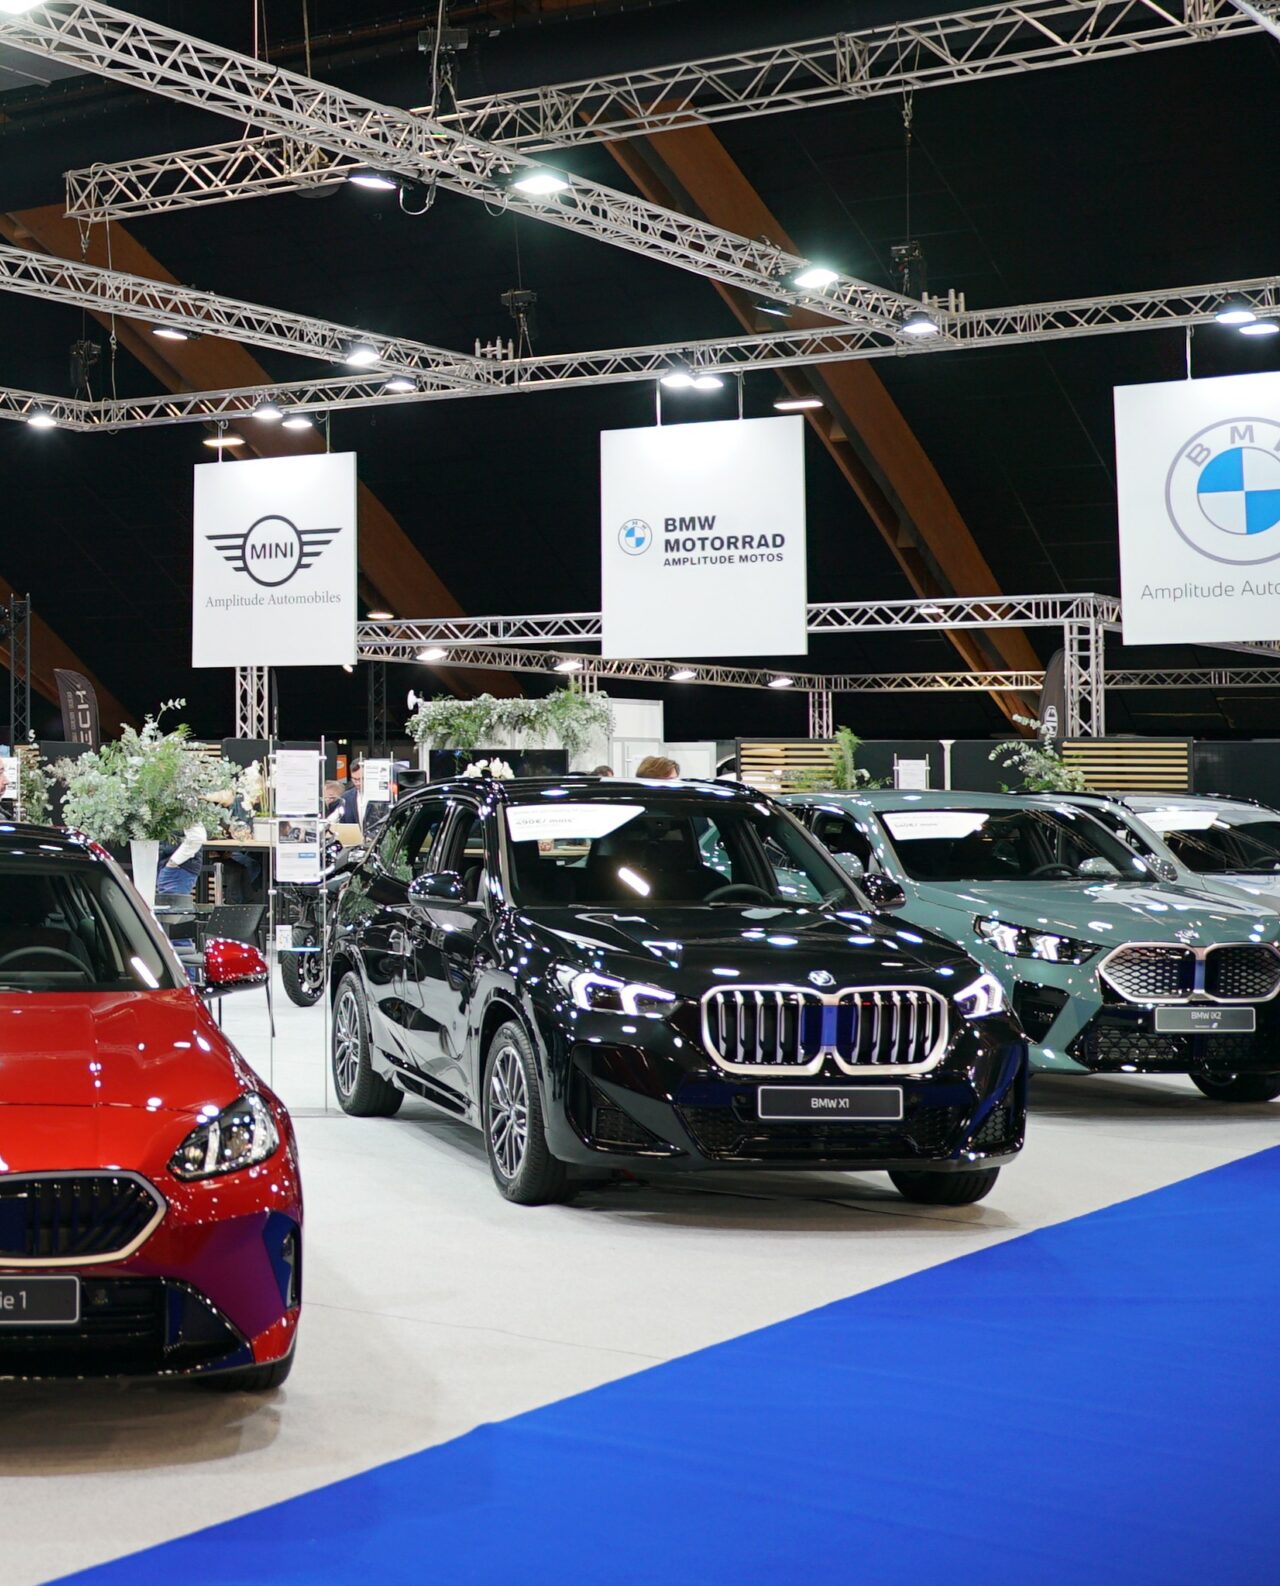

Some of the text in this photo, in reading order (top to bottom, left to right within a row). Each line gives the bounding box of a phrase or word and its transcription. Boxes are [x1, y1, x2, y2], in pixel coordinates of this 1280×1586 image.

[1185, 424, 1280, 467] BM
[664, 515, 716, 533] BMW
[250, 542, 294, 560] MINI
[664, 533, 786, 553] MOTORRAD
[663, 552, 784, 567] AMPLITUDE MOTOS
[205, 590, 342, 610] Amplitude Automobiles
[1140, 581, 1235, 602] Amplitude
[810, 1097, 850, 1109] BMW X1
[19, 1291, 27, 1309] 1
